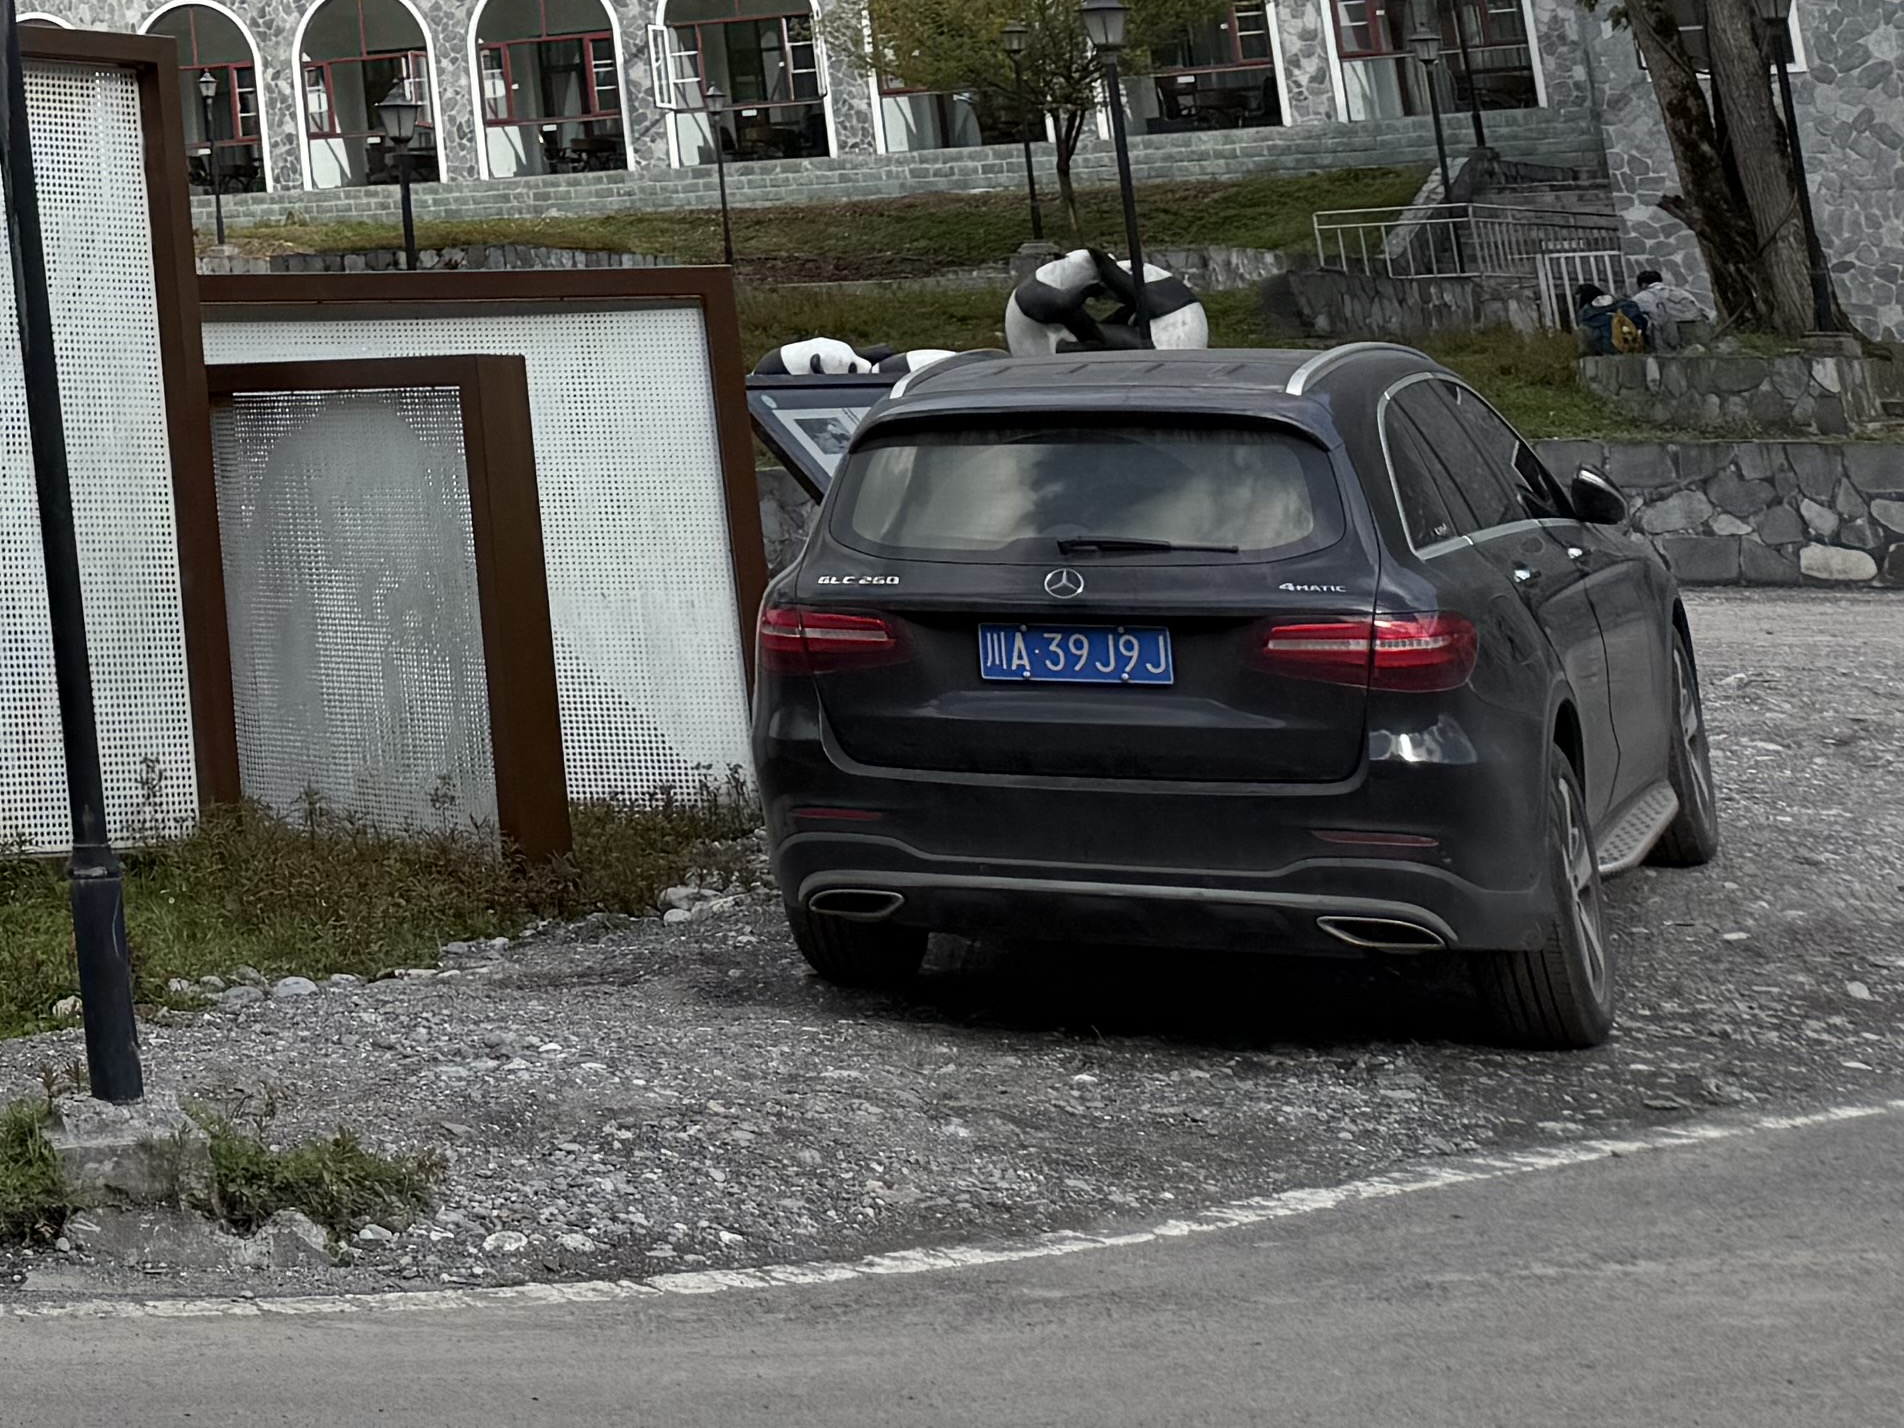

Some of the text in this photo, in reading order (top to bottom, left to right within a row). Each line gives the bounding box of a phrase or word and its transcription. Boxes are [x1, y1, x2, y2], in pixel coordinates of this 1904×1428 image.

[817, 575, 900, 585] GLC 260
[1278, 582, 1347, 593] 4MATIC
[986, 631, 1167, 674] 川A·39J9J
